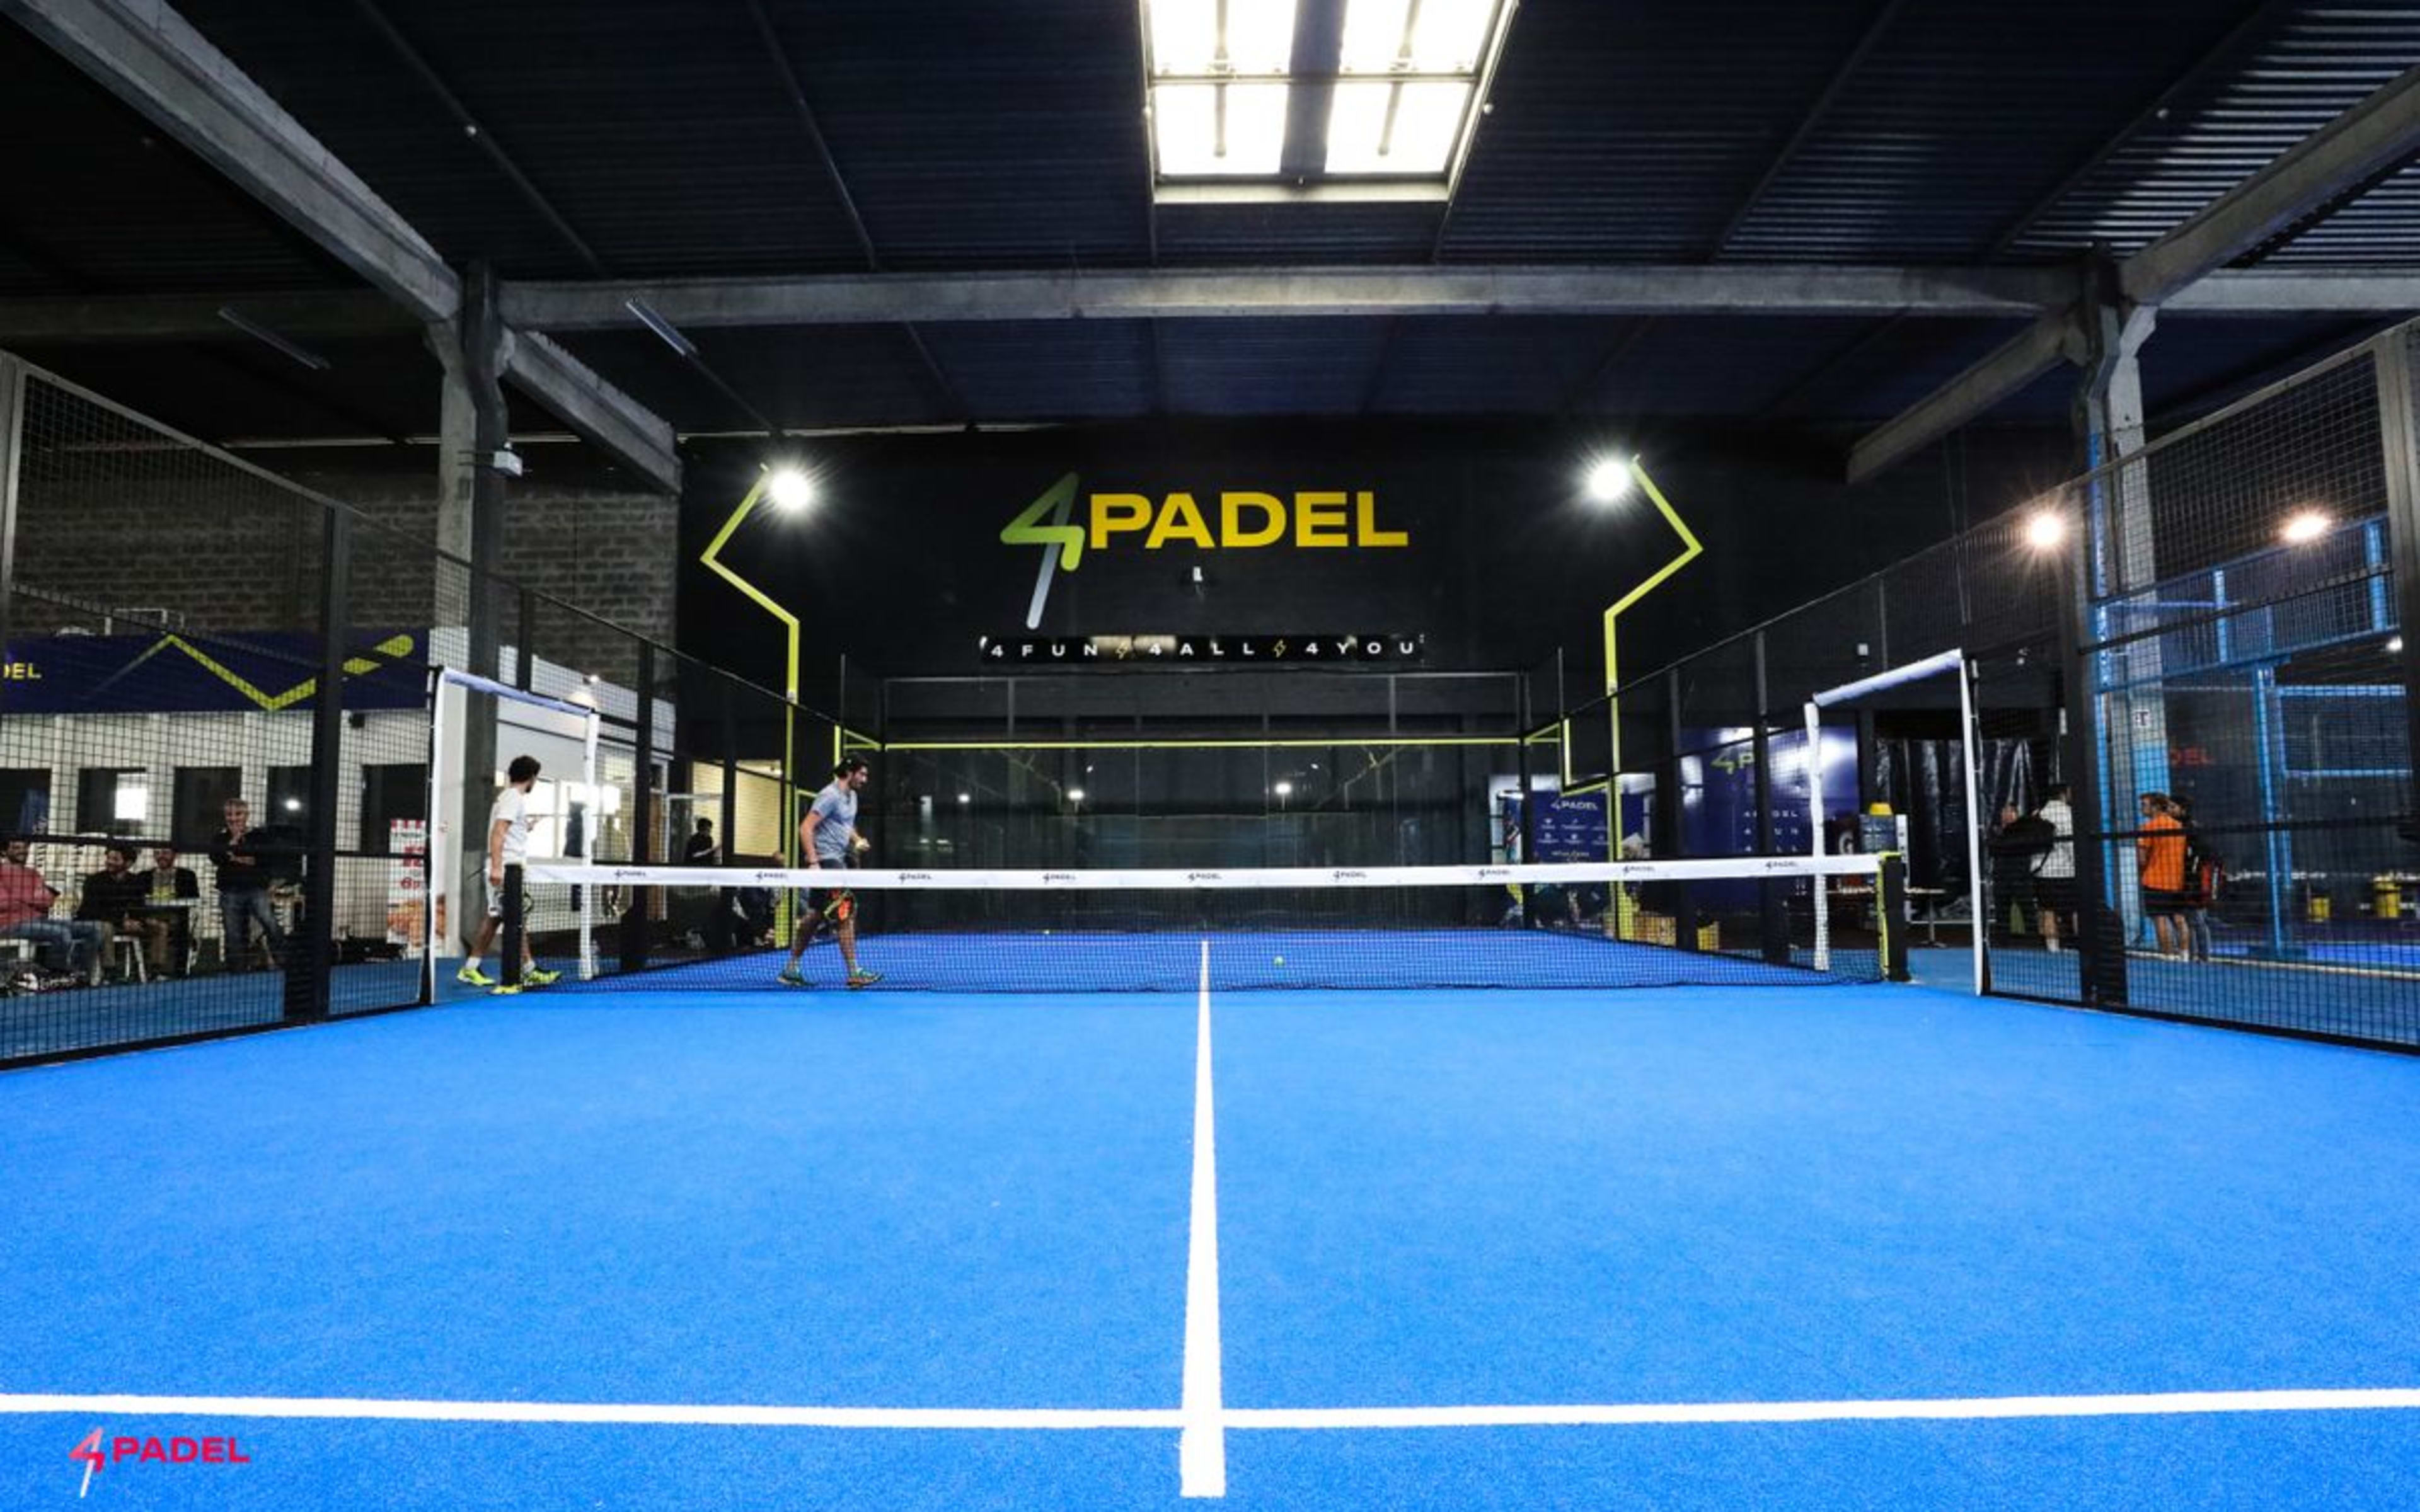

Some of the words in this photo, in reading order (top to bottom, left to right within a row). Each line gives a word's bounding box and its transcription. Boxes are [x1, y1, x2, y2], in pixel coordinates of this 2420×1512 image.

[1000, 471, 1409, 629] 4PADEL
[991, 643, 1098, 657] 4FUN
[1148, 643, 1255, 656] 4ALL
[1305, 641, 1414, 655] 4YOU
